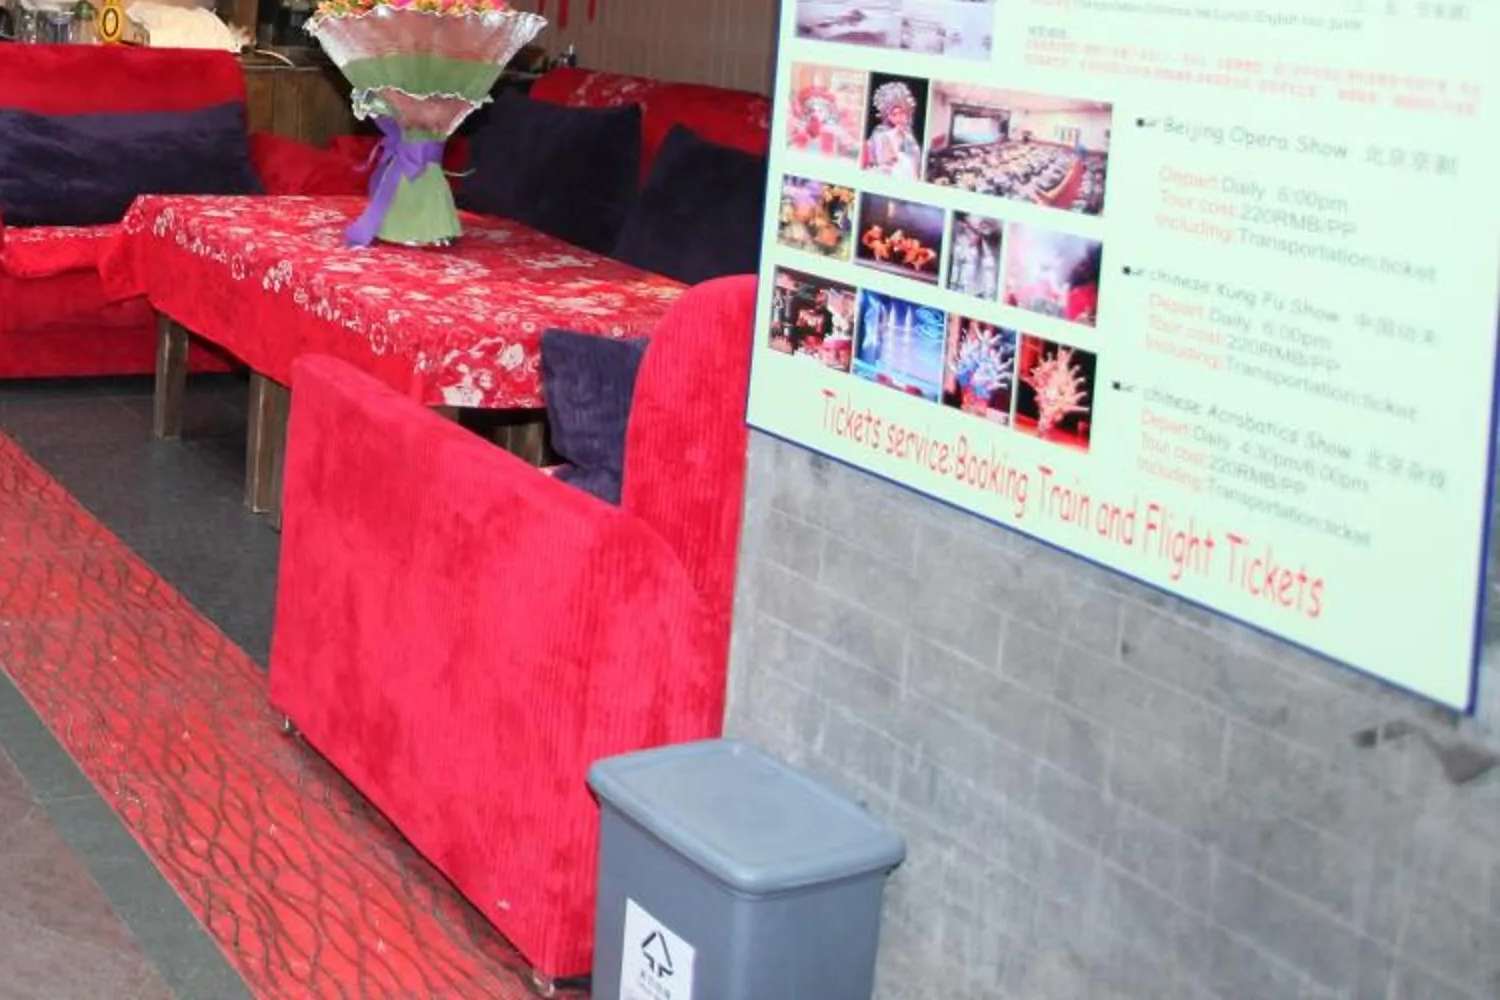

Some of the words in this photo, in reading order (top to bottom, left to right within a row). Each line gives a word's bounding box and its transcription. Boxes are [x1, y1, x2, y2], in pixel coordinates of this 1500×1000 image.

[1164, 116, 1225, 145] Beijing
[1229, 125, 1290, 152] Opera
[1296, 135, 1348, 159] Show
[1221, 176, 1266, 201] Daily
[1290, 298, 1340, 323] Show
[1304, 429, 1352, 459] Show
[820, 388, 883, 451] Tickets
[1037, 465, 1090, 523] Train
[1097, 497, 1136, 547] and
[1143, 502, 1215, 581] Flight
[1227, 532, 1325, 619] Tickets
